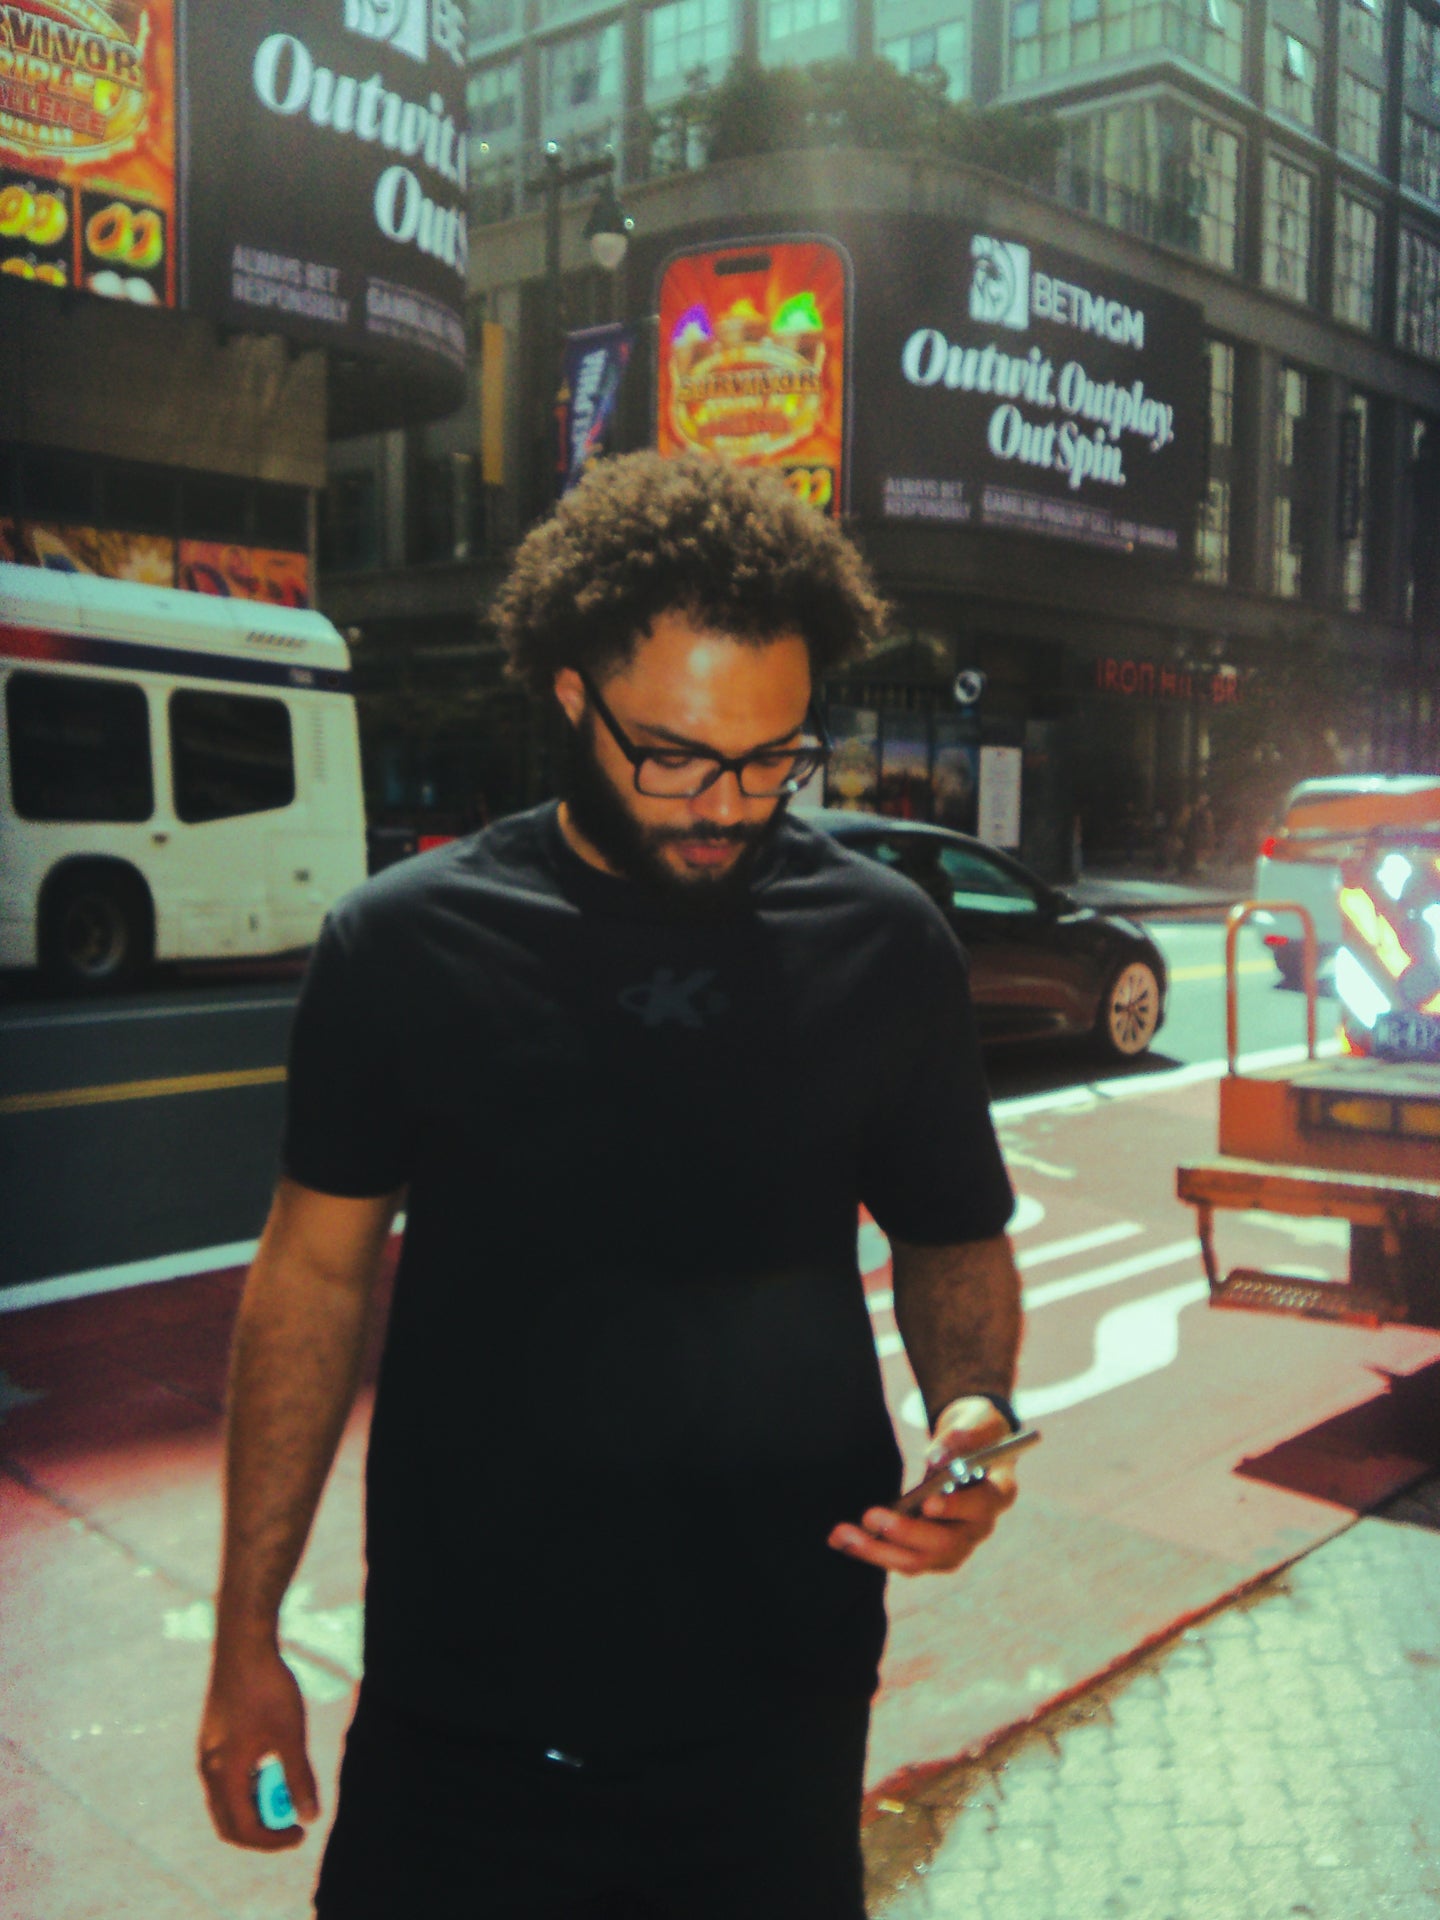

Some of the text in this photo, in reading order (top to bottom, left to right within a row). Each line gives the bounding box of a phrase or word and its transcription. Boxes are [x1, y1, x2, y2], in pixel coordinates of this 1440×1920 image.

[1031, 271, 1145, 350] BETMGM
[902, 328, 1057, 408] Outwit.
[1096, 658, 1155, 697] IRON
